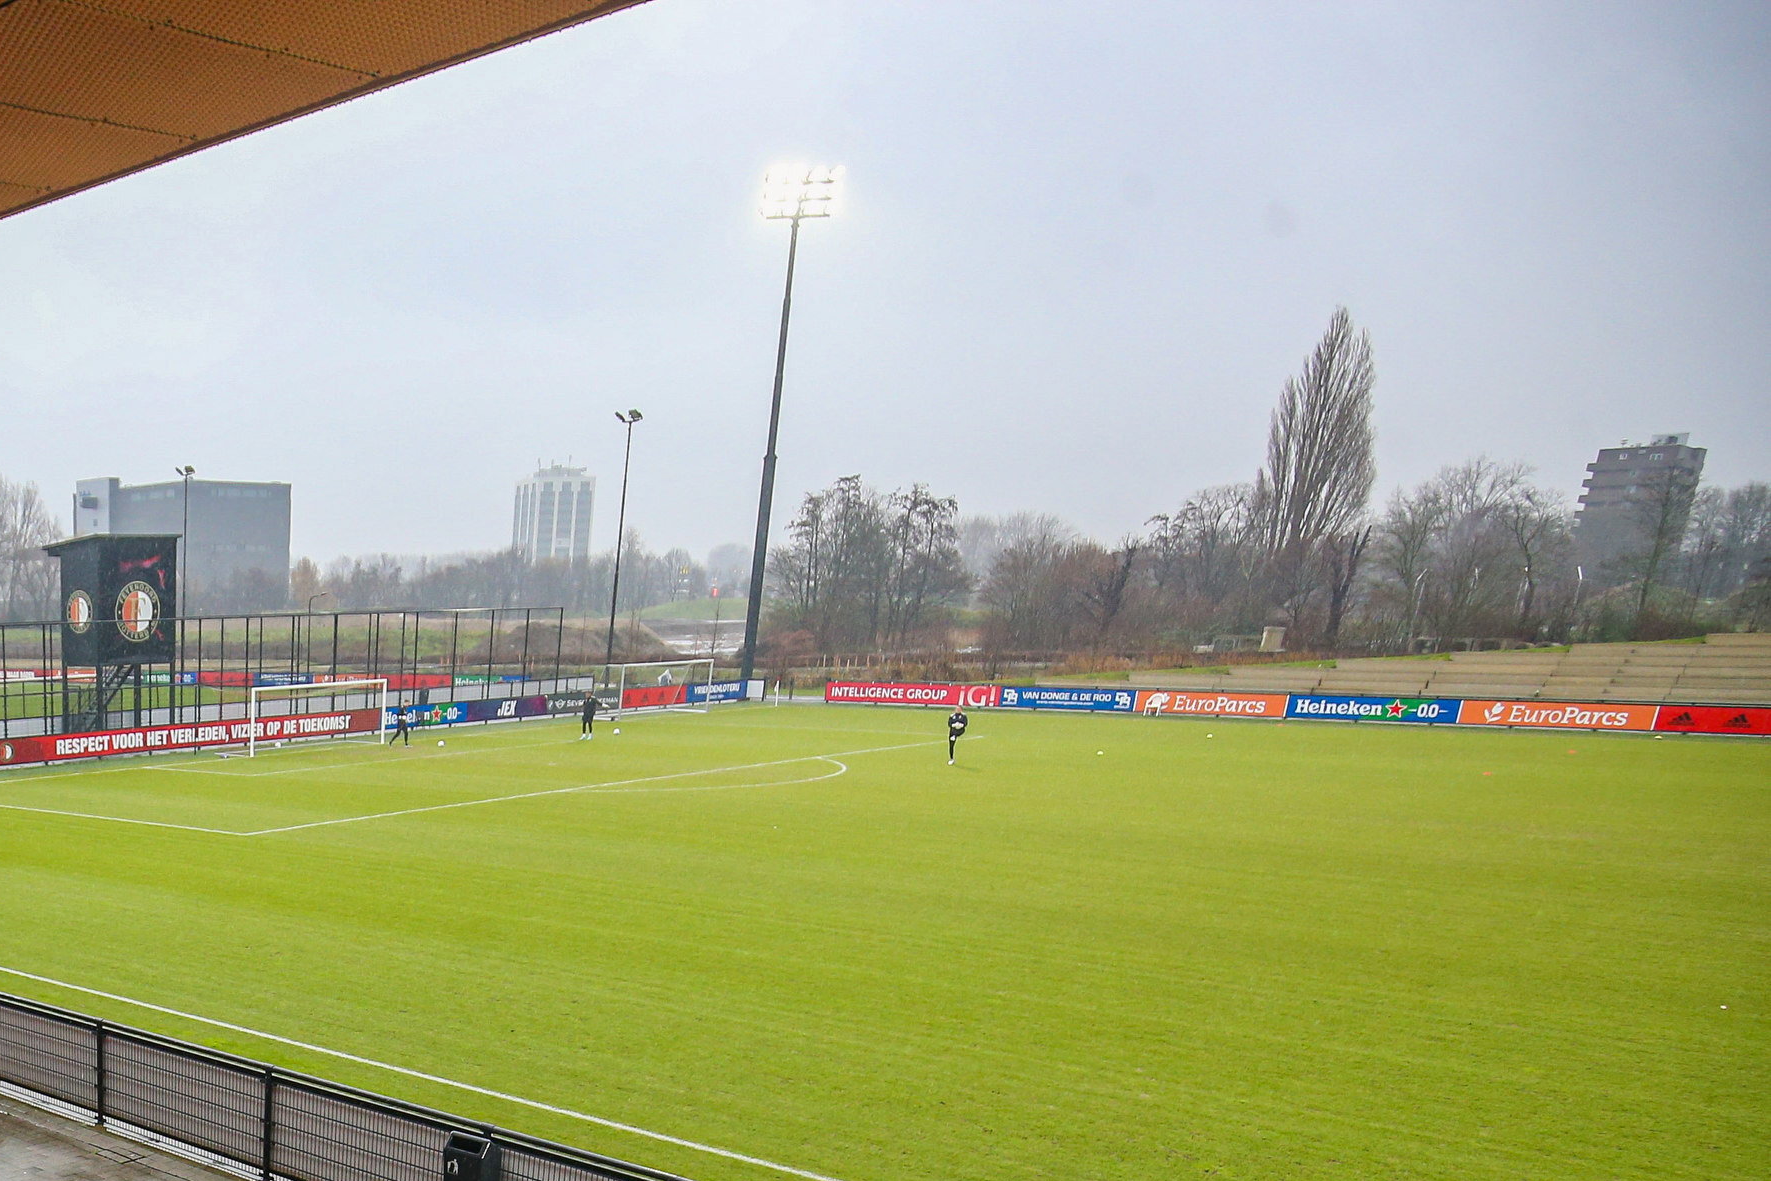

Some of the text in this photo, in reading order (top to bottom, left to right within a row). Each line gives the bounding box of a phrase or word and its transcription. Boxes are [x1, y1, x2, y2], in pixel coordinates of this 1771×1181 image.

[831, 686, 948, 700] INTELLIGENCE GROUP
[1022, 691, 1112, 702] VAN DONGE & DE ROO
[1173, 695, 1266, 714] EuroParcs
[1295, 699, 1382, 716] Heineken
[1507, 705, 1629, 726] EuroParcs
[56, 735, 109, 755] RESPECT
[111, 732, 144, 750] VOOR
[146, 730, 169, 747] HET
[170, 725, 229, 744] VERLEDEN,
[267, 721, 281, 736] OP
[283, 719, 298, 734] DE
[298, 715, 351, 733] TOEKOMST
